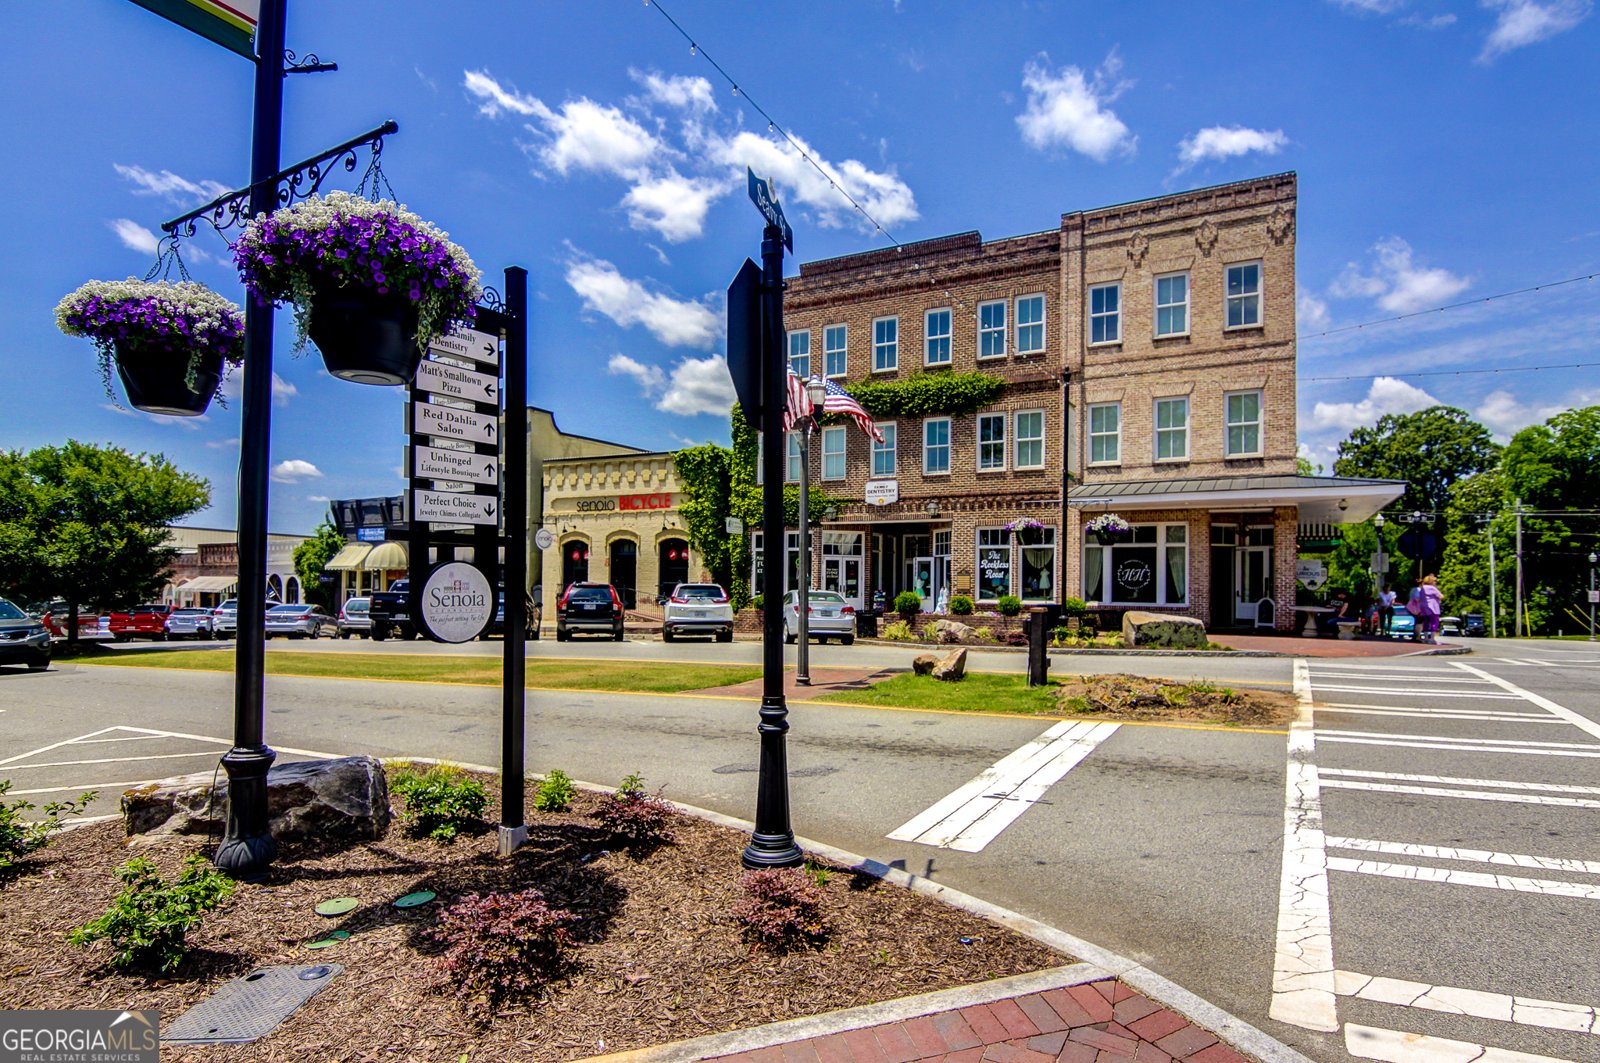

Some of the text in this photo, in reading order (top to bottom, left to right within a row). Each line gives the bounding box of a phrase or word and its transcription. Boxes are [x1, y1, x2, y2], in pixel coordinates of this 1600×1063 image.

[434, 336, 468, 354] Dentistry
[420, 363, 482, 386] Matt's Smalltown
[442, 381, 461, 394] Pizza
[423, 408, 477, 426] Red Dahlia
[437, 422, 463, 434] Salon
[430, 451, 472, 466] Unhinged
[421, 464, 480, 478] Lifestyle Boutique
[424, 494, 477, 508] Perfect Choice
[576, 492, 672, 512] senoia BICYCLE
[419, 508, 438, 518] Jewelry
[988, 550, 1001, 559] The
[430, 587, 485, 608] Senoia
